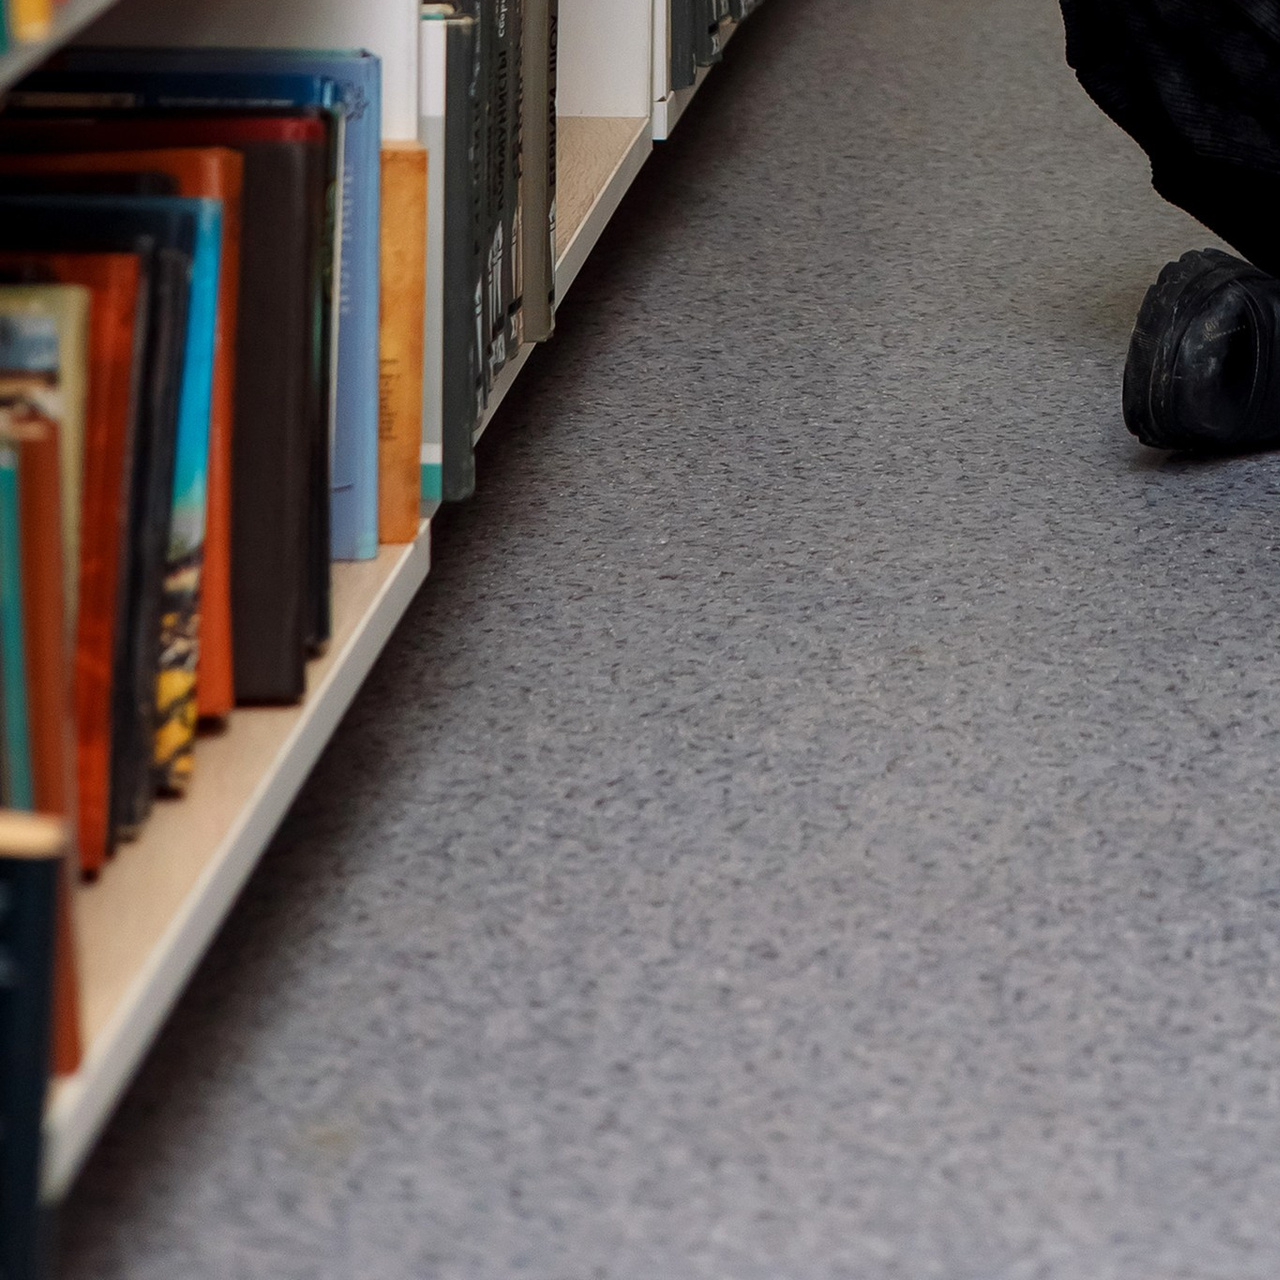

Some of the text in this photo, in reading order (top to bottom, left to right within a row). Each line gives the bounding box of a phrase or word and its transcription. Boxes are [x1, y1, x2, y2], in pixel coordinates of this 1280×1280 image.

[497, 50, 508, 210] КОММУНИСТЫ
[548, 14, 558, 187] БЕРНАРД ШОУ
